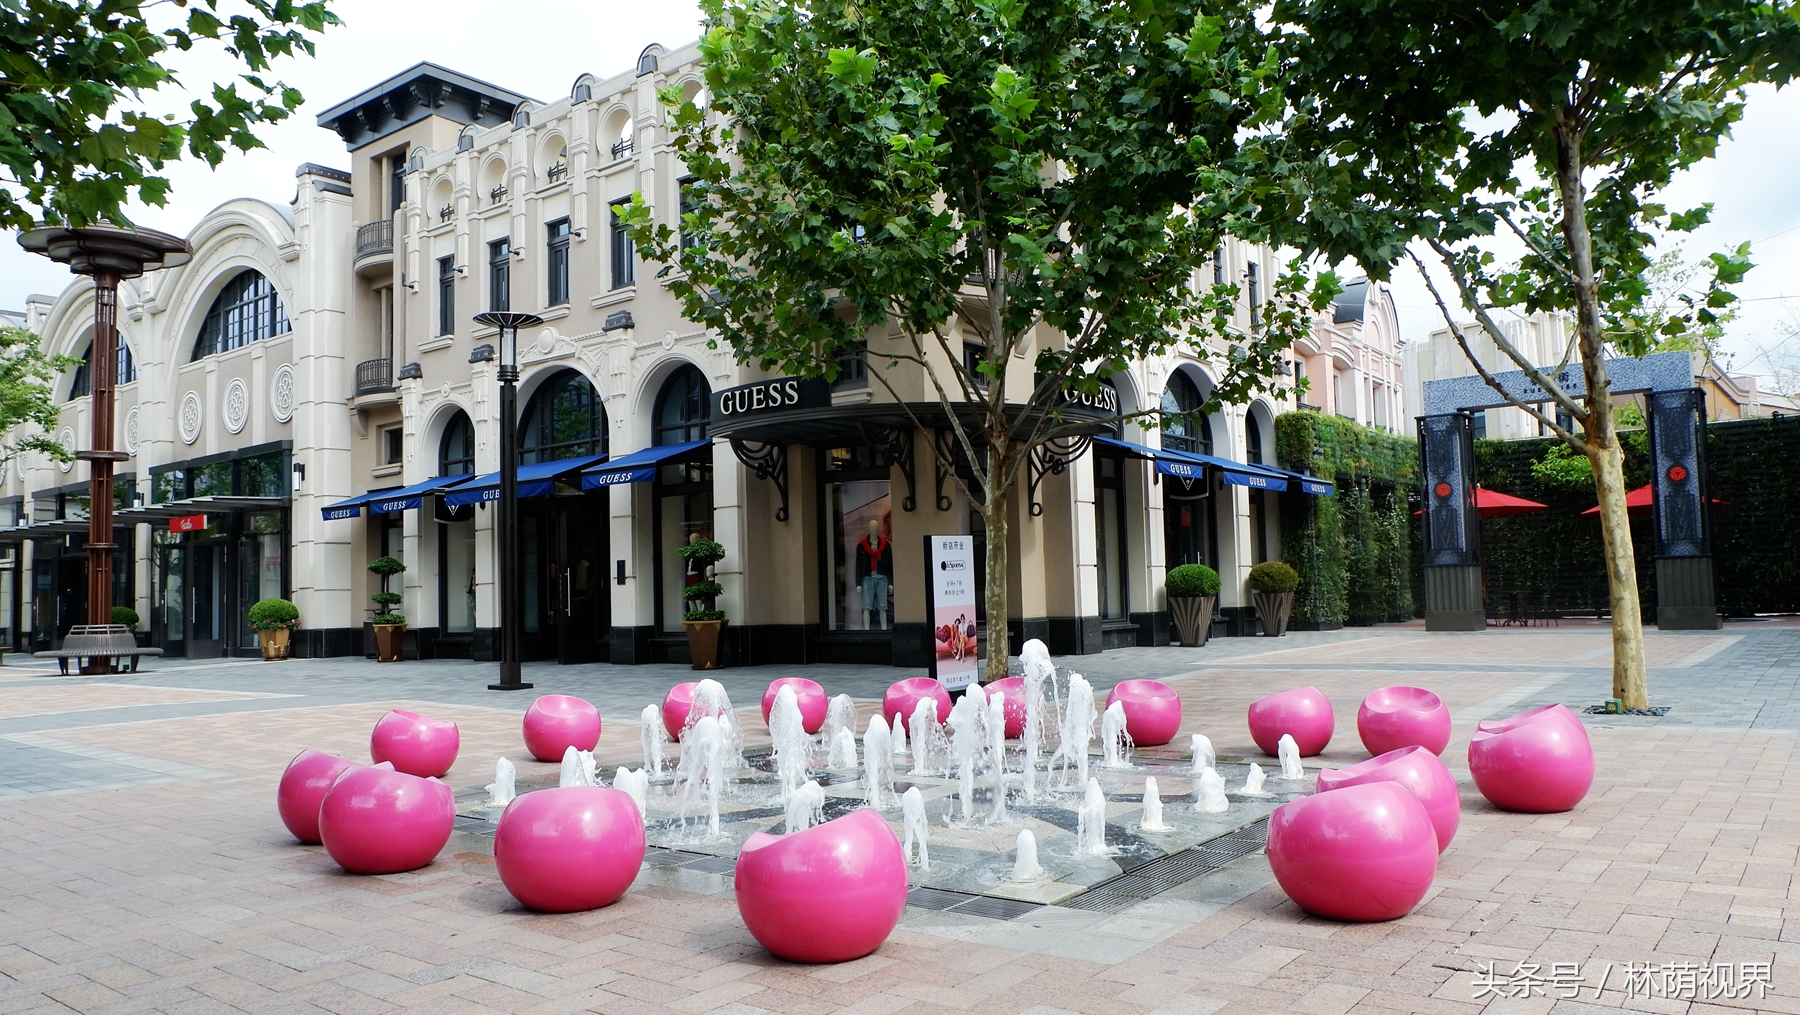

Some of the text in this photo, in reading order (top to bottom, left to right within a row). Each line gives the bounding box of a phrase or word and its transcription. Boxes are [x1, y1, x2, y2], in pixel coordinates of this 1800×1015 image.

[720, 381, 799, 415] GUESS
[1064, 386, 1116, 412] GUESS
[1170, 463, 1192, 475] GUESS
[599, 472, 632, 484] GUESS
[1249, 476, 1267, 487] GUESS
[1310, 484, 1326, 493] GUESS
[483, 489, 500, 500] GUE
[382, 500, 407, 511] GUESS
[330, 509, 351, 519] GUESS
